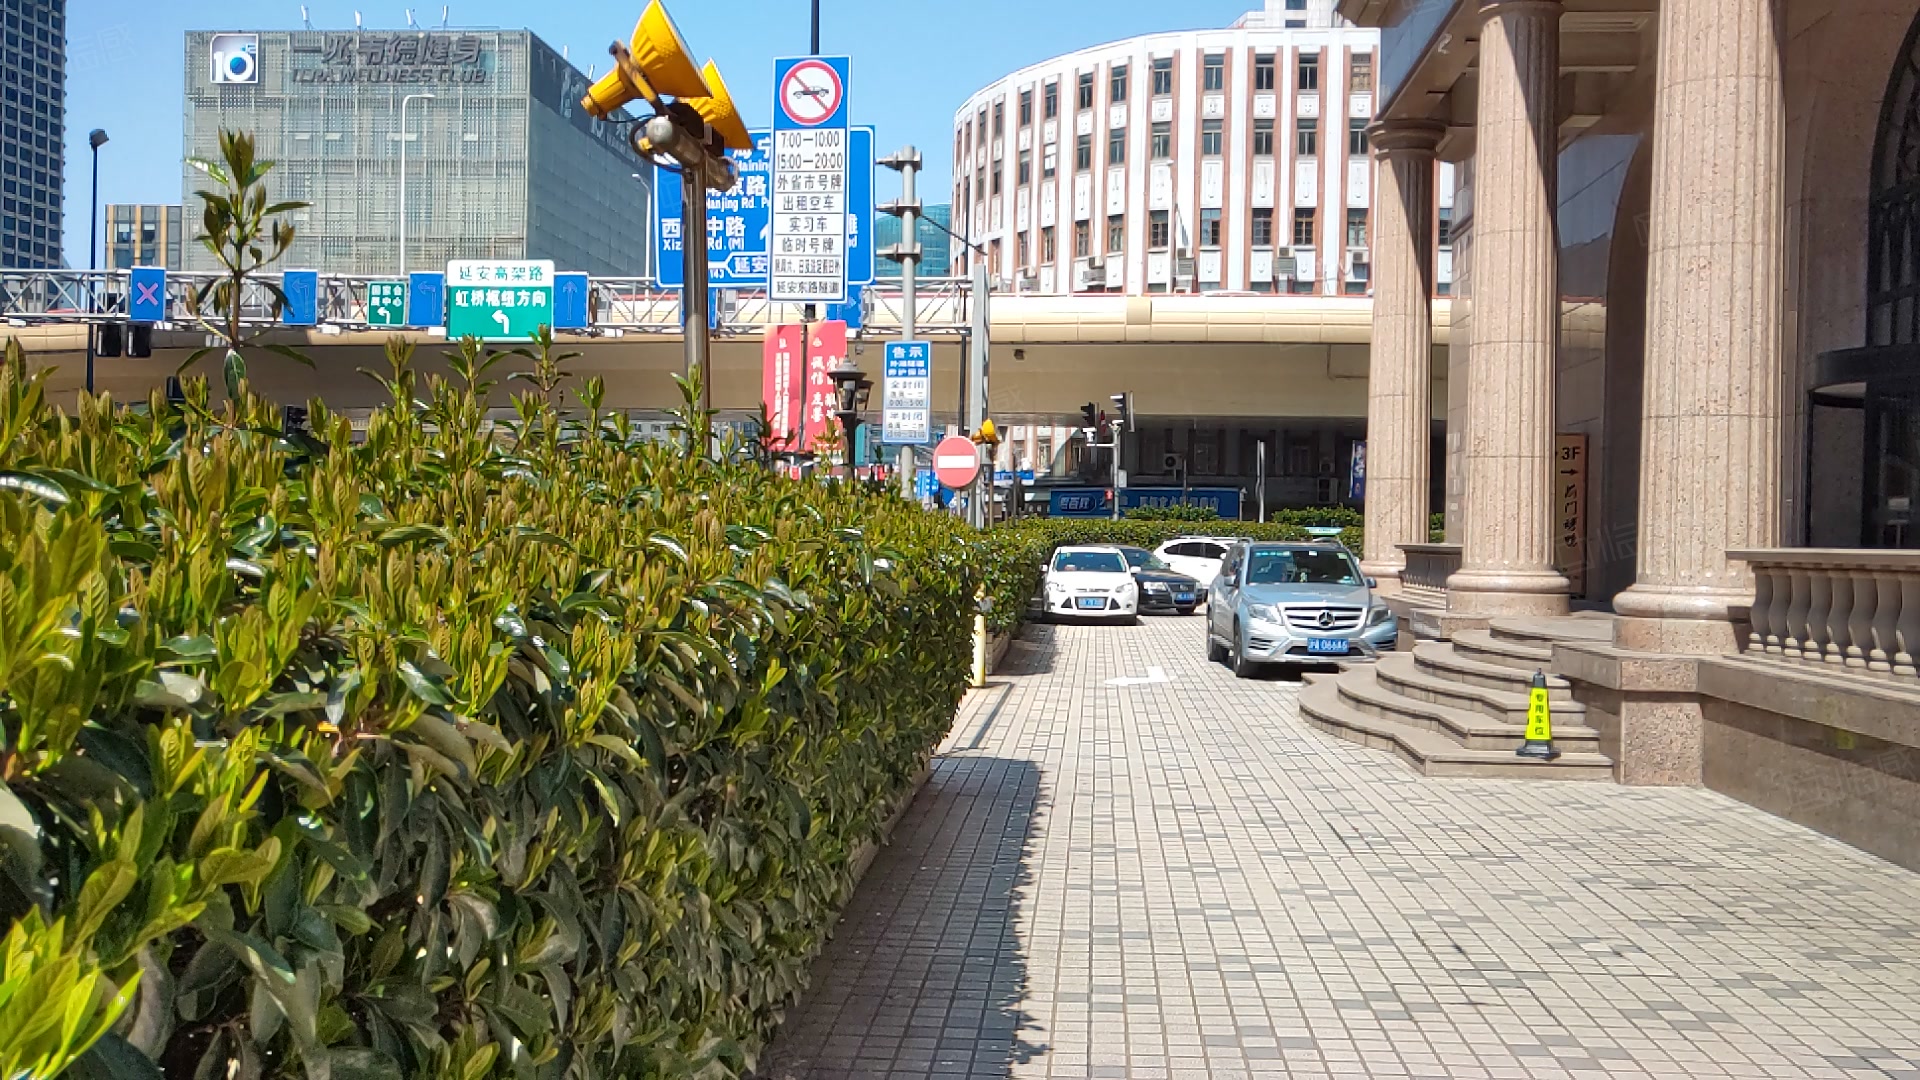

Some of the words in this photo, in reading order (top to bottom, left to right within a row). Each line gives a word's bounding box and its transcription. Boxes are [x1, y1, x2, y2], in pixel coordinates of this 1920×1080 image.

[293, 34, 482, 66] 一兆韦德健身
[777, 173, 842, 191] 外省市号牌
[782, 195, 834, 211] 出租空车
[789, 215, 828, 233] 实习车
[782, 236, 834, 254] 临时号牌
[459, 265, 544, 282] 延安高架路
[776, 281, 840, 294] 延安东路隧道
[455, 289, 547, 308] 虹桥枢纽方向
[892, 346, 923, 359] 告示
[1561, 446, 1581, 461] 3F
